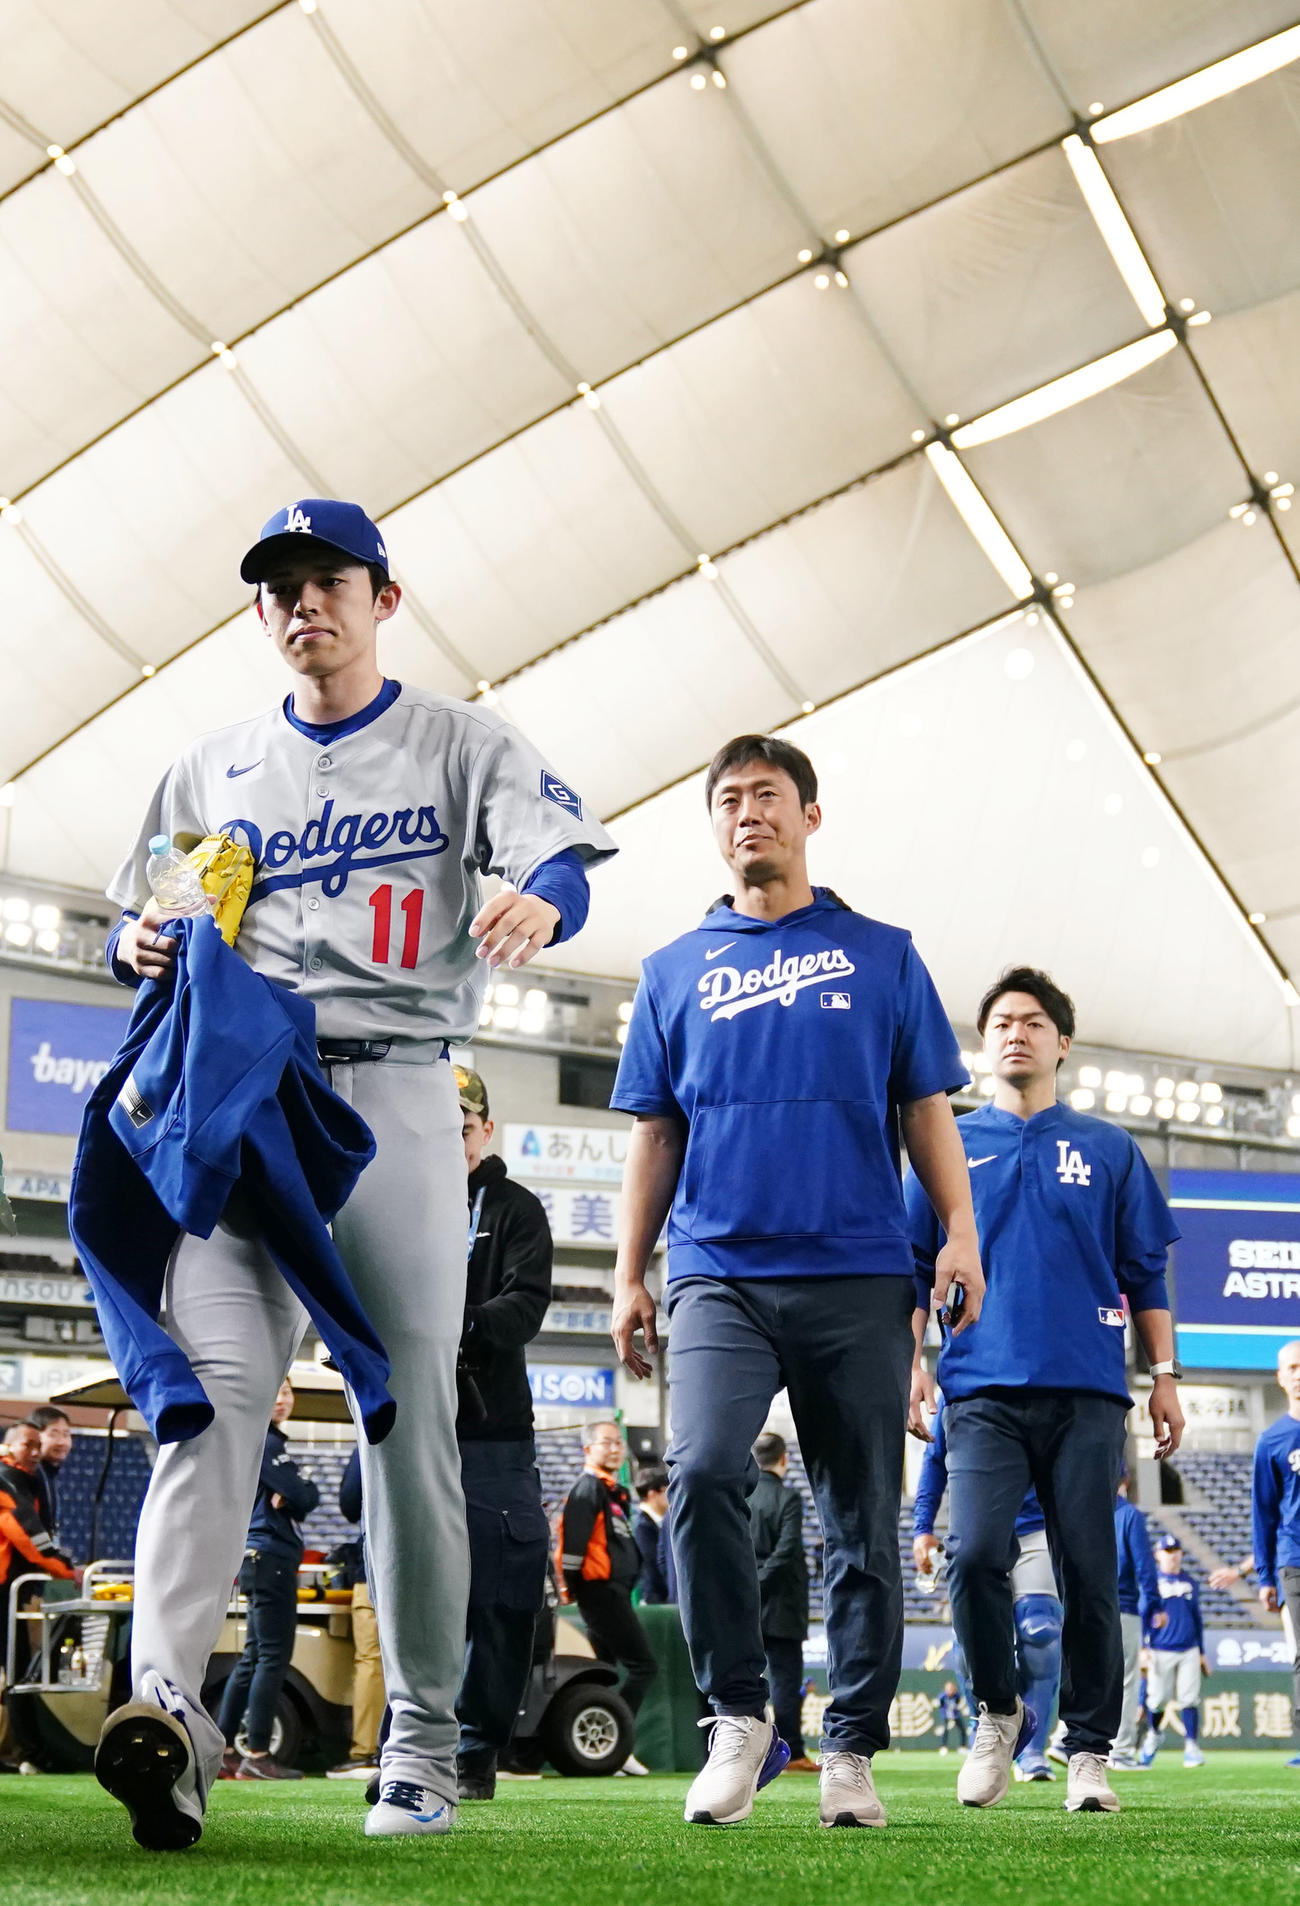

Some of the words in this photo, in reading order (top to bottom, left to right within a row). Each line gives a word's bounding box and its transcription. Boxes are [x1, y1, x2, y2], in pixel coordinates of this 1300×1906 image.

[284, 504, 312, 534] LA
[369, 884, 424, 969] 11
[698, 949, 855, 1022] Dodgers
[1056, 1140, 1091, 1186] LA
